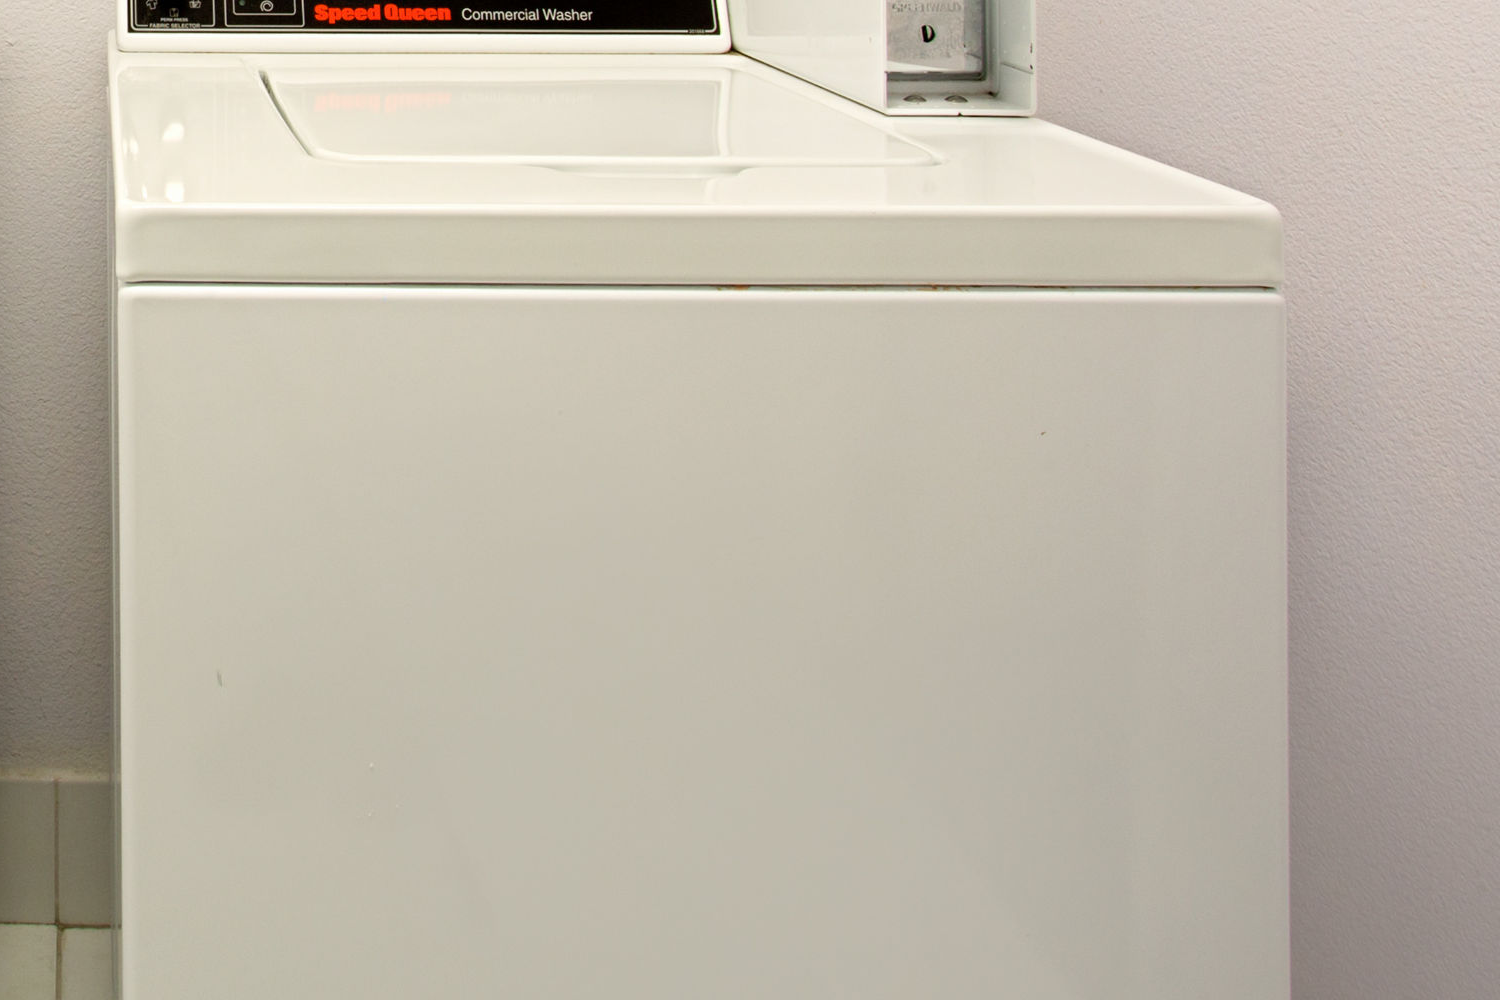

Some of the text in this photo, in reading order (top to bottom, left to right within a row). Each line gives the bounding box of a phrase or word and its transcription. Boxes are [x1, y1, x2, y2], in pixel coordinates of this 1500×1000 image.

[313, 3, 593, 25] Speed Queen Commercial Washer
